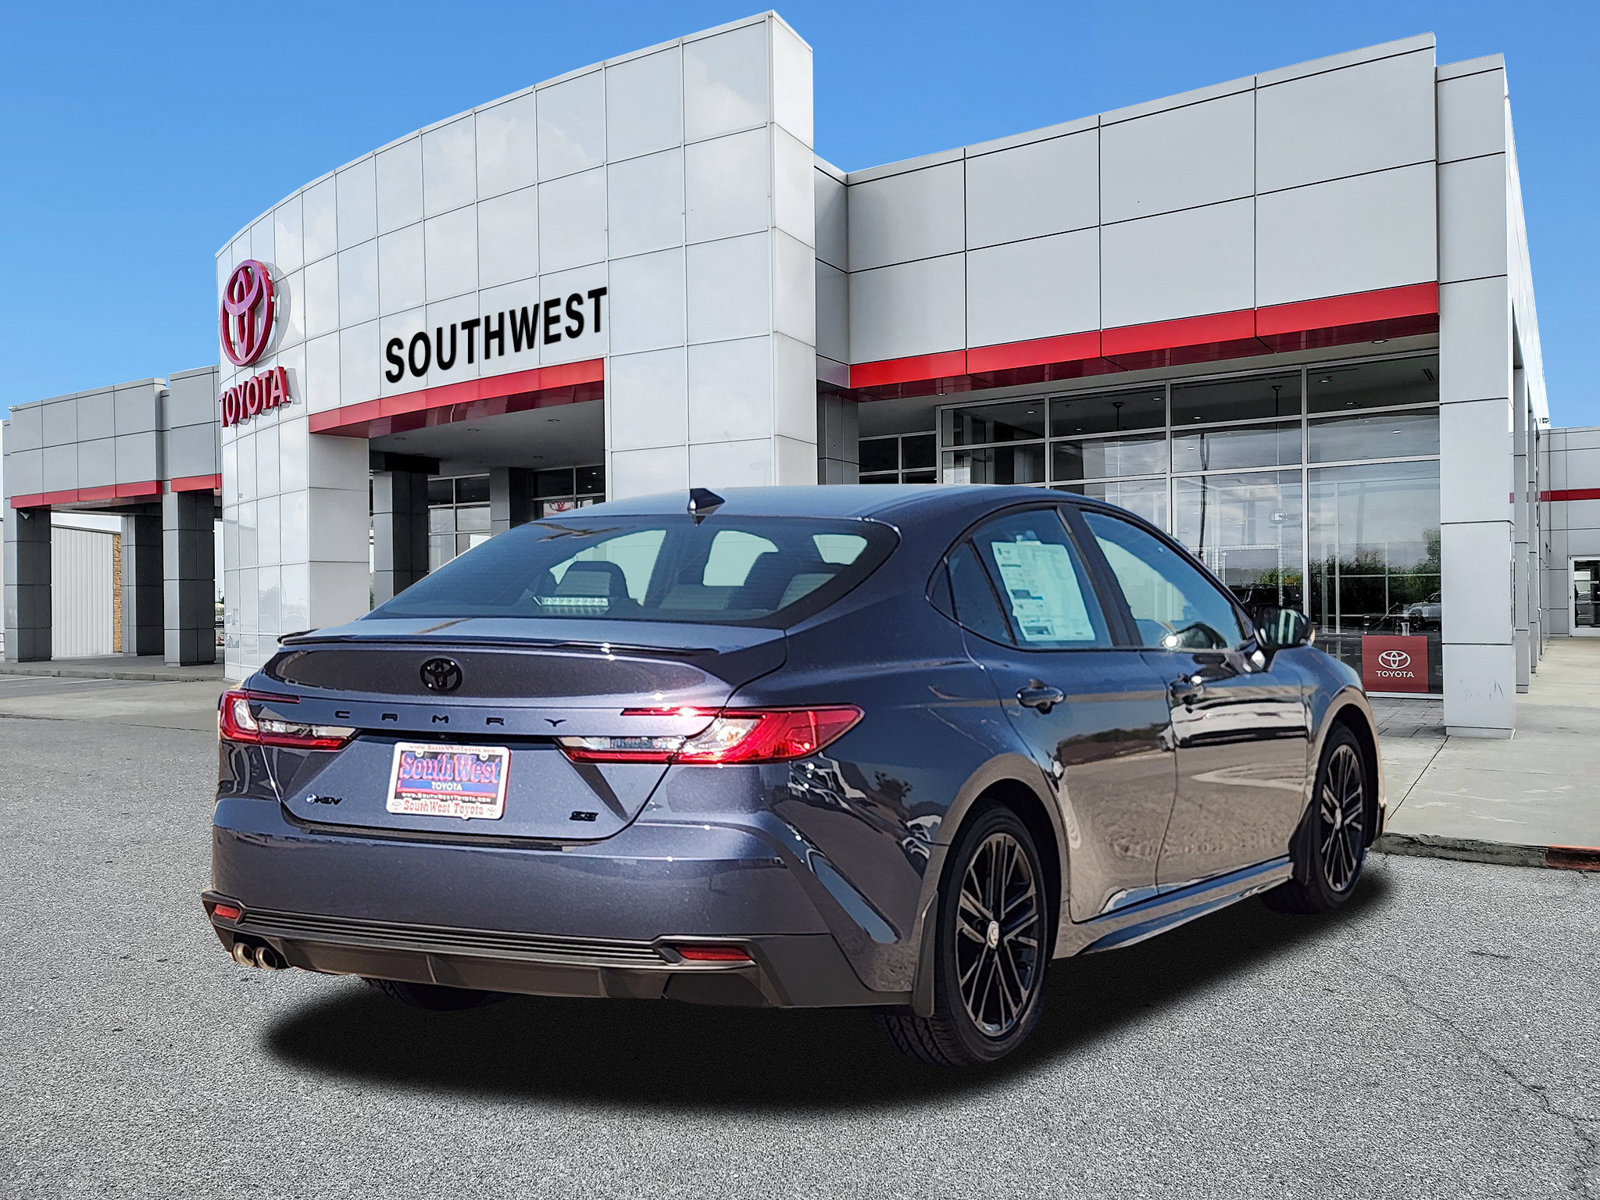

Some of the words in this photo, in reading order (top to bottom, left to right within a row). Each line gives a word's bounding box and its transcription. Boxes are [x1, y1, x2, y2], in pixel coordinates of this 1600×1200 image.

[385, 286, 608, 384] SOUTHWEST
[219, 366, 290, 428] TOYOTA
[1376, 670, 1415, 678] TOYOTA
[335, 710, 567, 727] CAMRY
[431, 782, 462, 791] TOYOTA
[454, 802, 484, 817] Toyota
